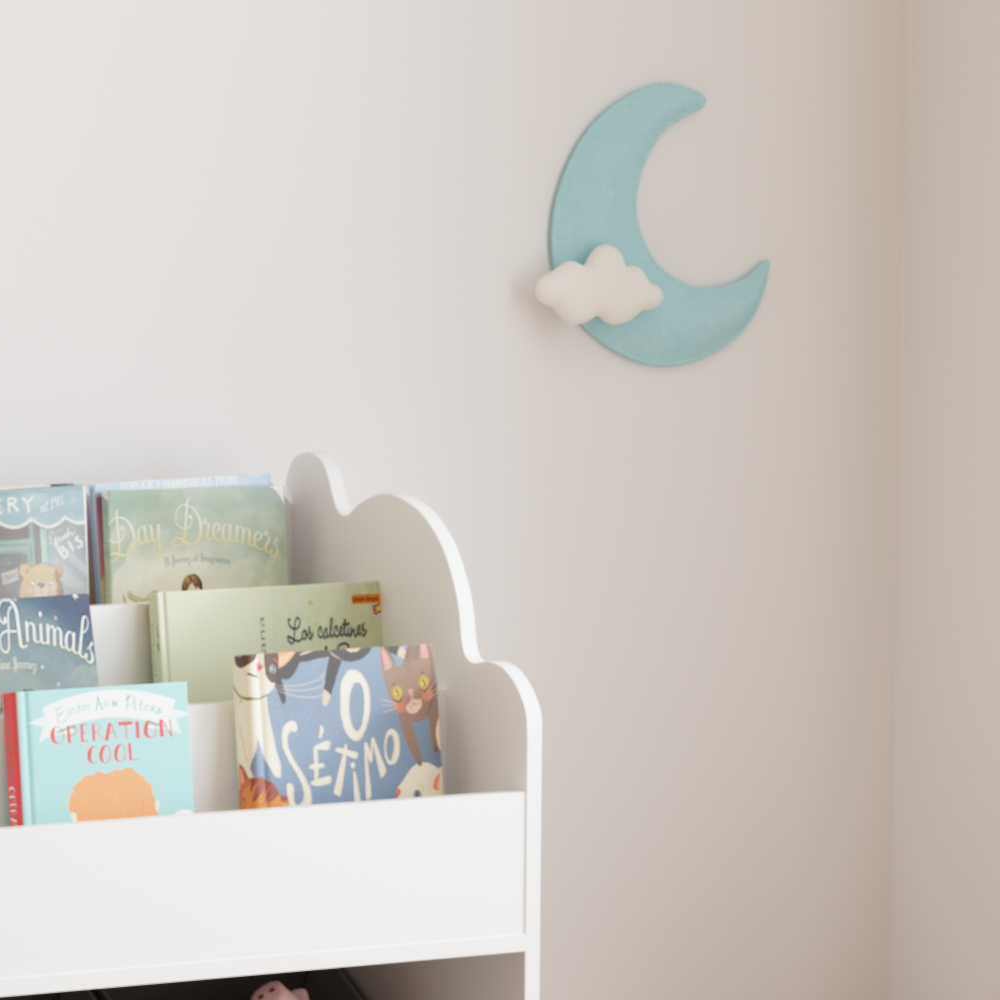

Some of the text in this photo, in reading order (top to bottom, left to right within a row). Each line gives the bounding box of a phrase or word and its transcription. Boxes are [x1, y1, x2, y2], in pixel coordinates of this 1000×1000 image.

[107, 496, 281, 564] Day Dreamers
[286, 616, 314, 645] Los
[316, 616, 368, 639] calcetines
[55, 701, 91, 724] Easter
[50, 718, 174, 746] OPERATION
[86, 742, 140, 765] COOL
